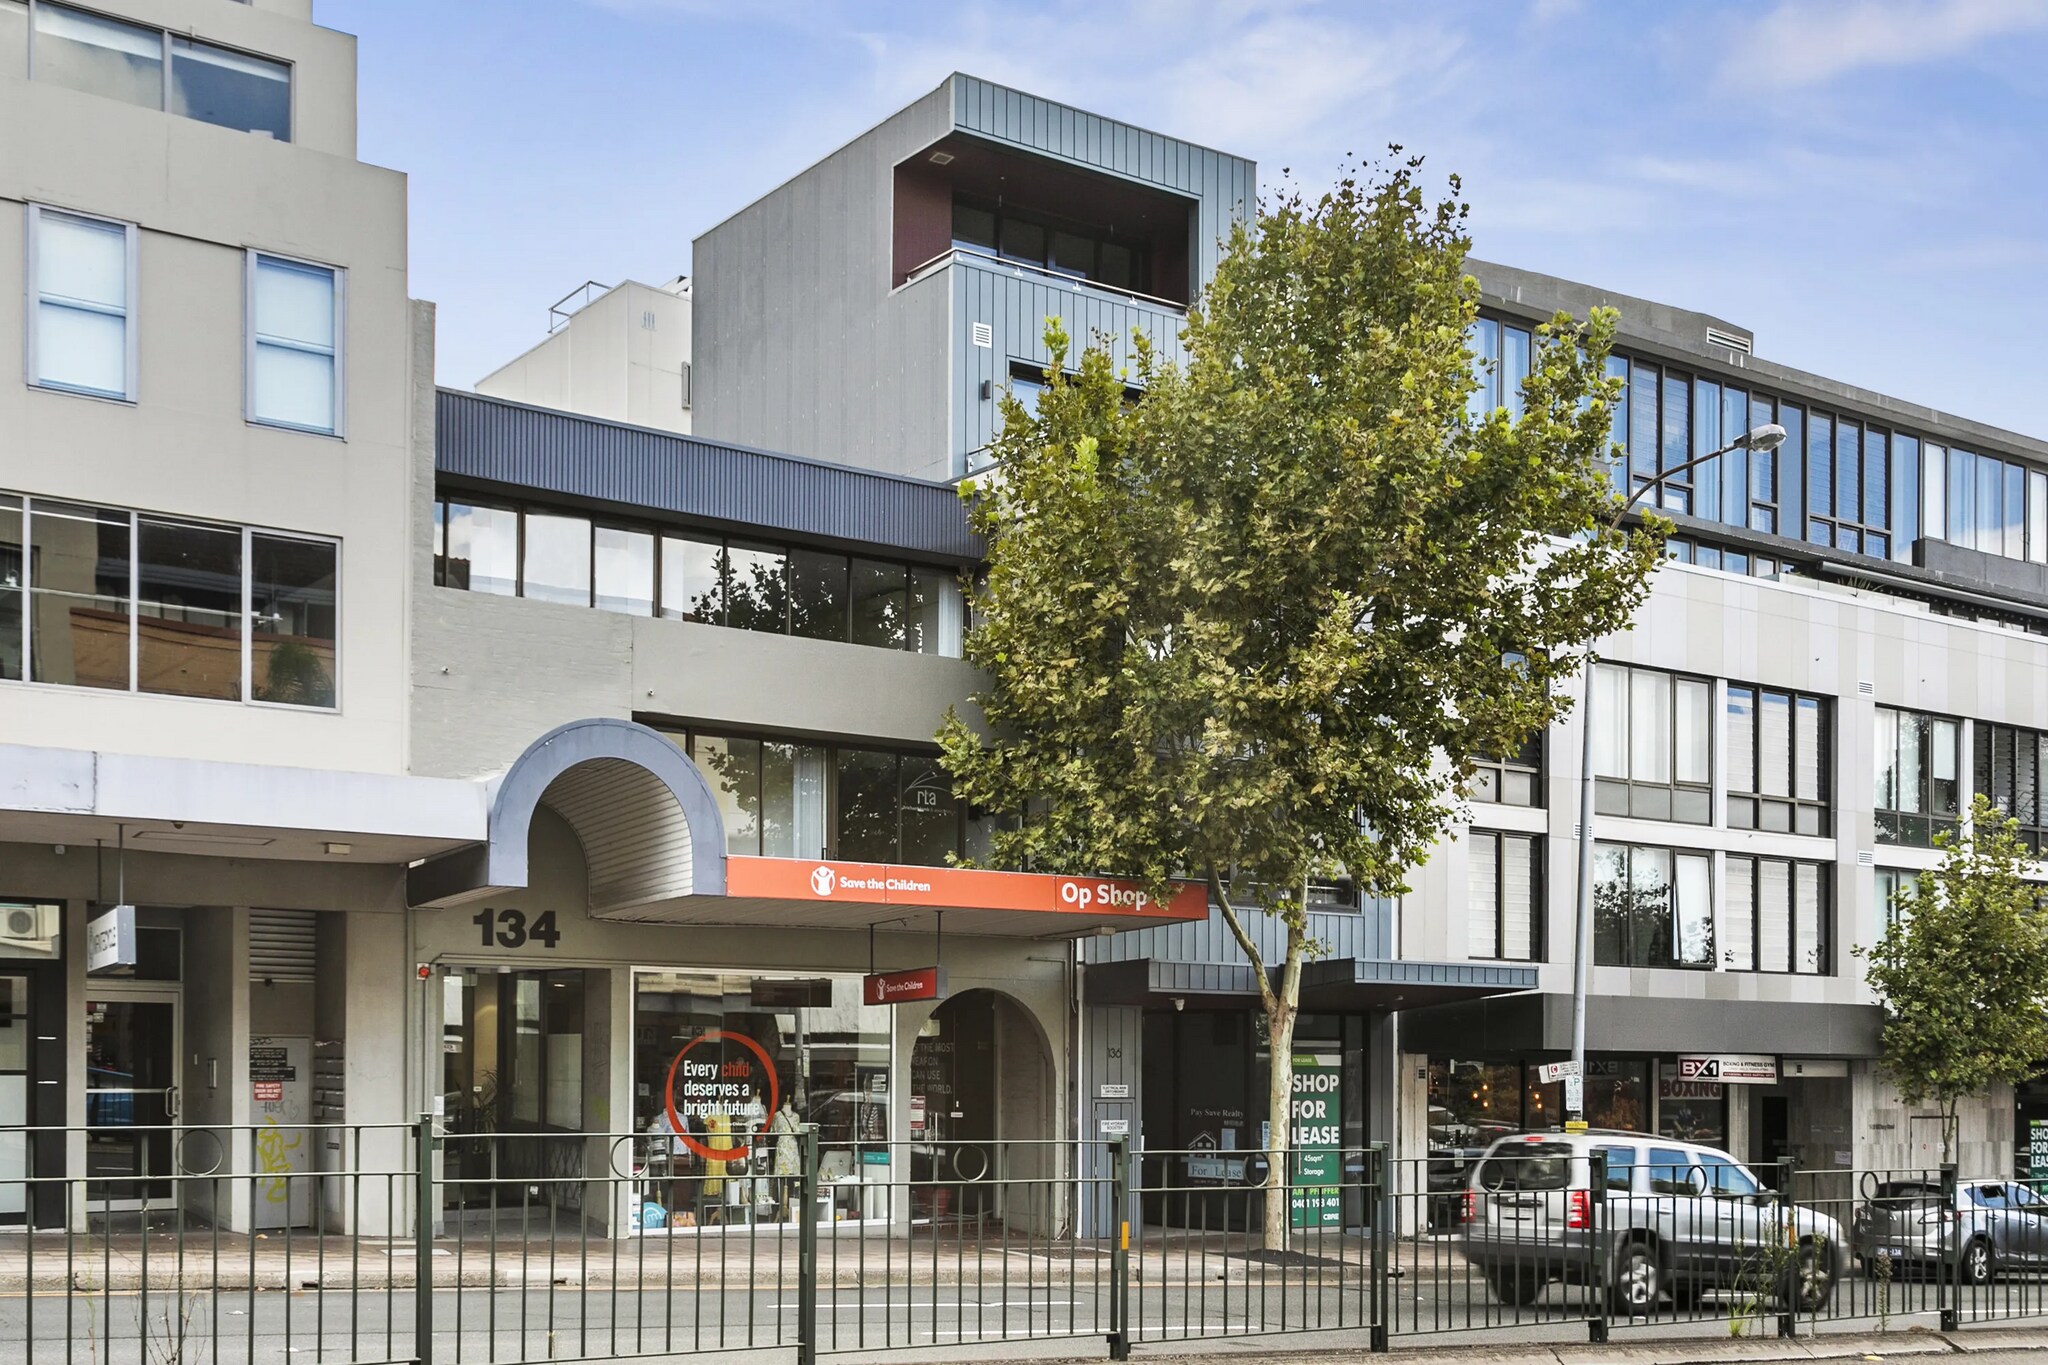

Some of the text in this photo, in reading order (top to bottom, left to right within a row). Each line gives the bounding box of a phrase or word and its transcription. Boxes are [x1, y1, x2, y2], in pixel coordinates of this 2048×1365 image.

[840, 876, 931, 892] Save the Children
[1061, 882, 1147, 911] Op Shop
[473, 907, 561, 949] 134
[886, 983, 897, 993] Save
[904, 981, 924, 991] Children
[1106, 1047, 1122, 1059] 136
[684, 1060, 750, 1080] Every child
[1682, 1057, 1718, 1079] BX1
[684, 1080, 750, 1096] deserves a
[1292, 1074, 1340, 1093] SHOP
[1660, 1080, 1721, 1098] BOXING
[684, 1099, 760, 1120] bright future
[1190, 1107, 1244, 1119] Pay Save Realty
[1292, 1100, 1327, 1119] FOR
[1292, 1126, 1340, 1145] LEASE
[1191, 1165, 1242, 1178] For Lease
[1304, 1168, 1325, 1177] Storage
[1326, 1198, 1340, 1207] 401
[1323, 1213, 1340, 1221] CBRE
